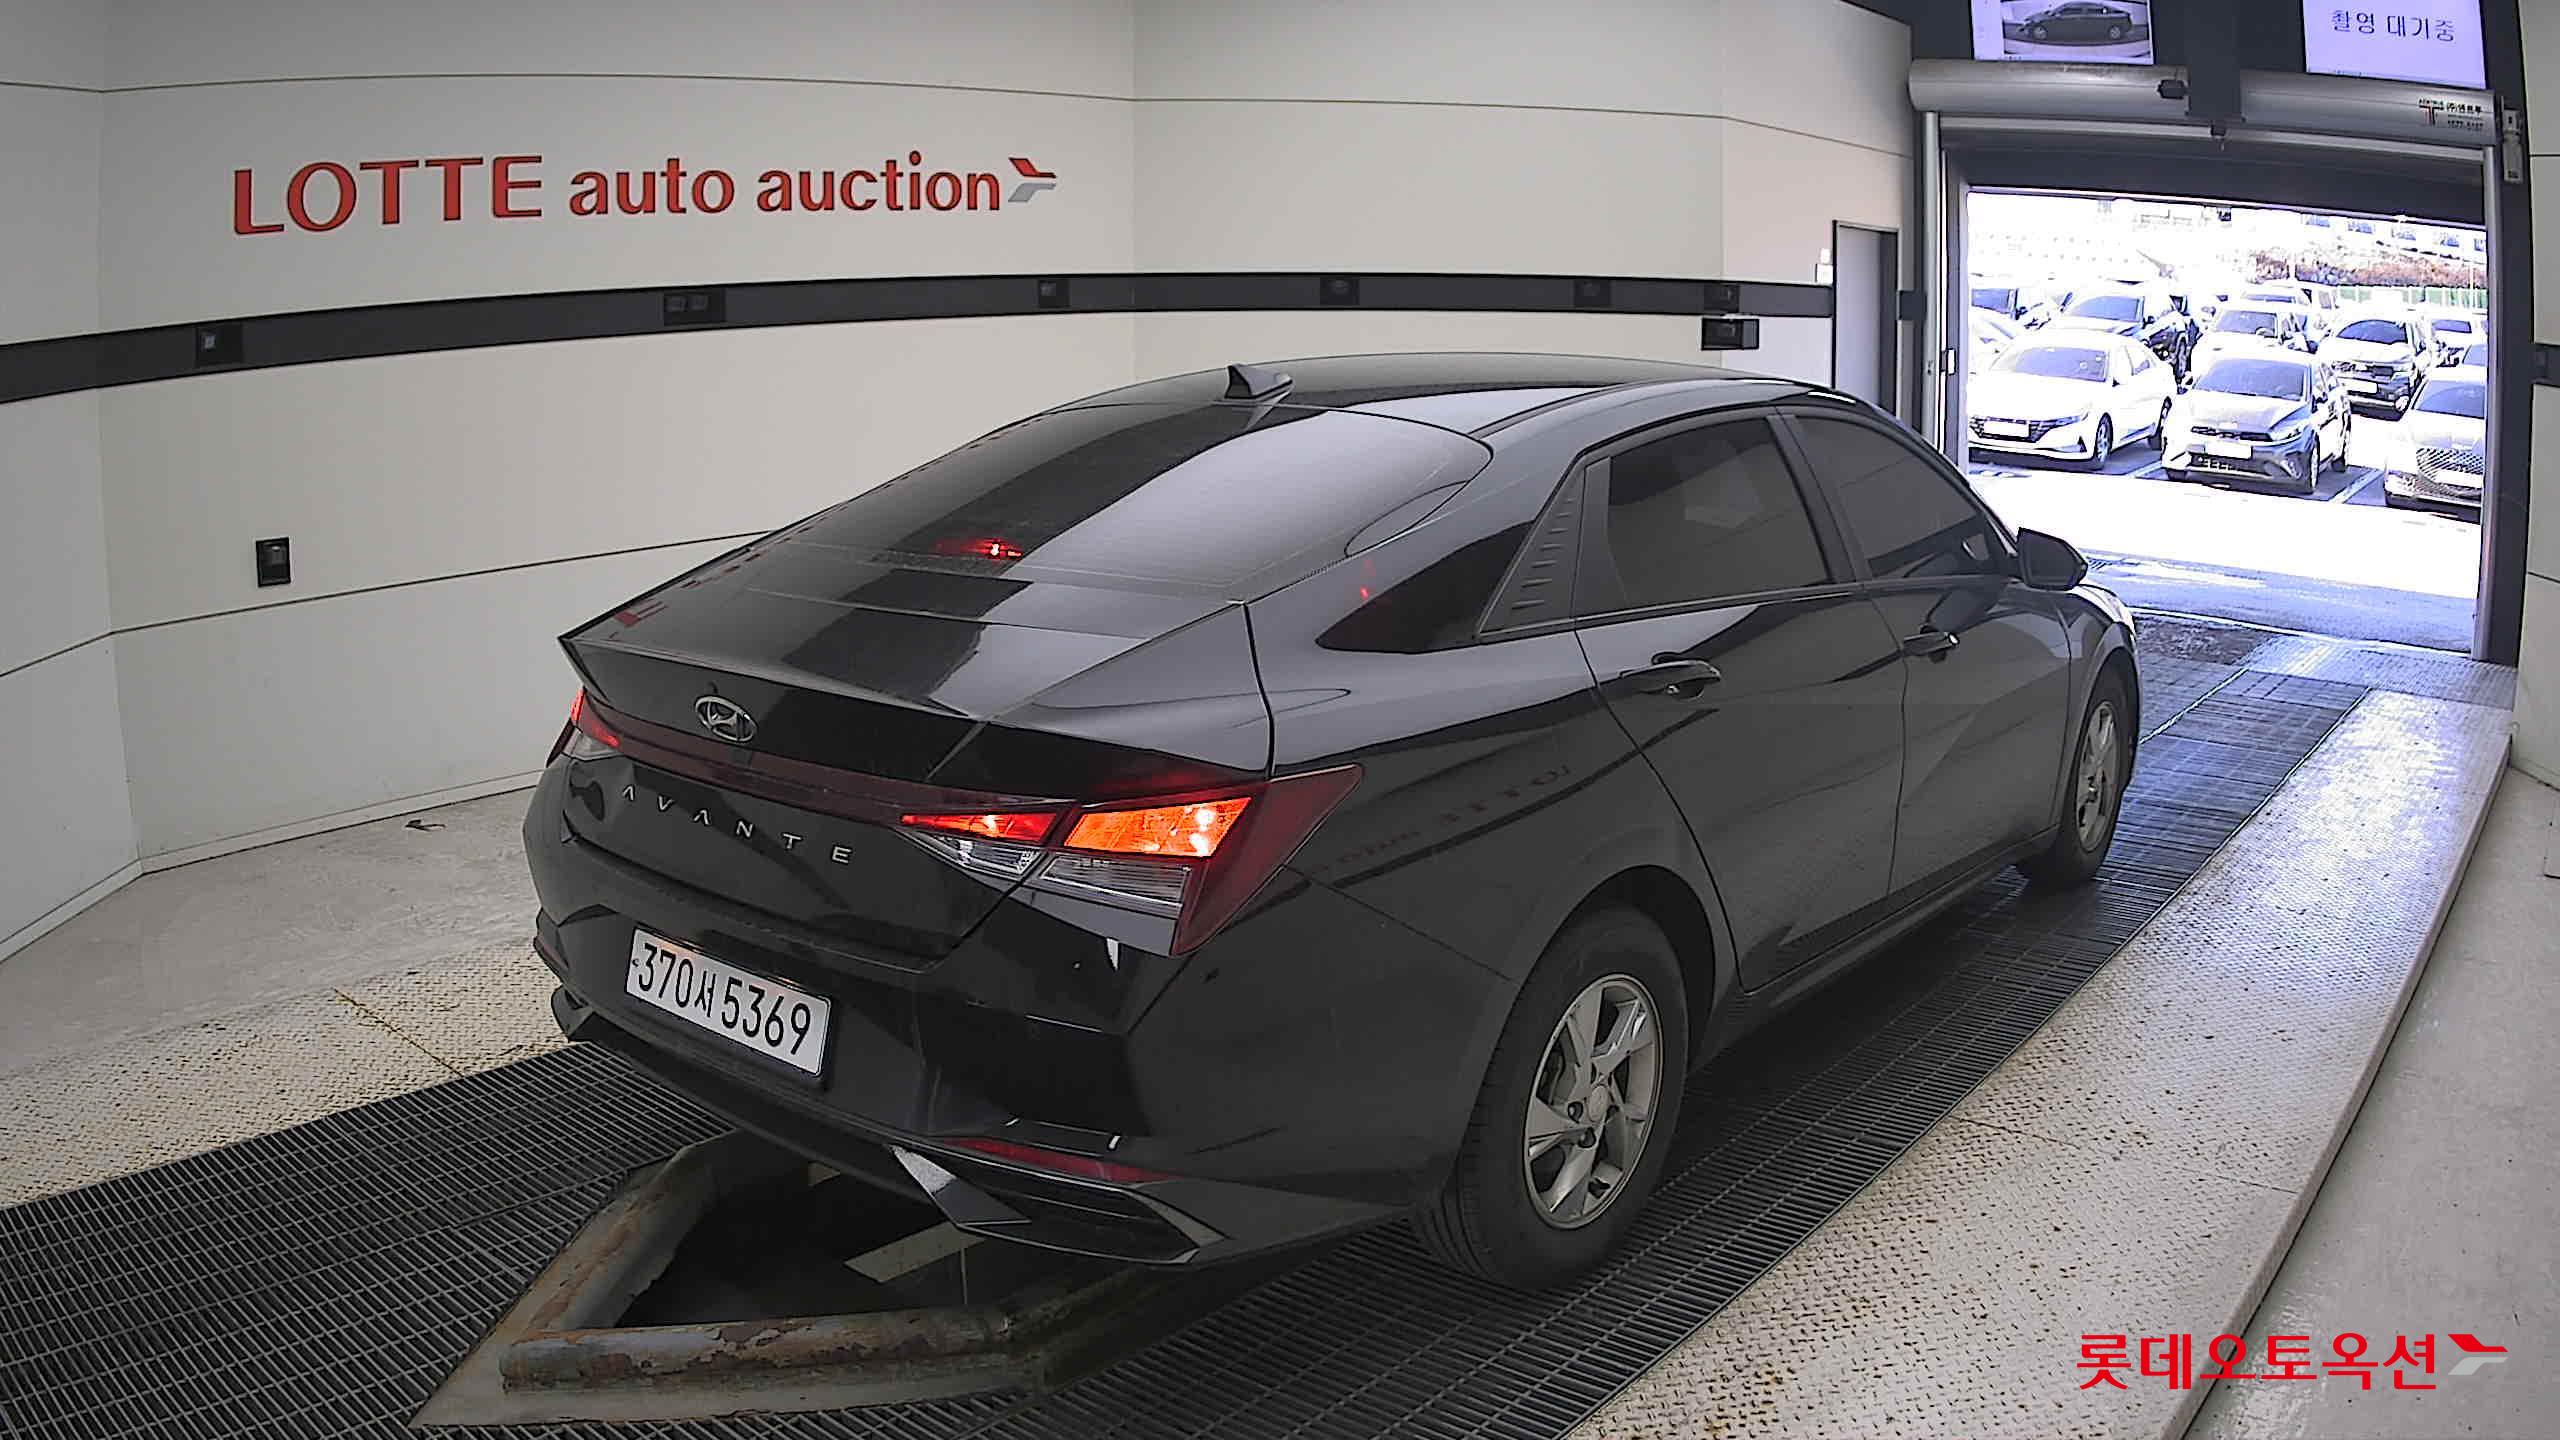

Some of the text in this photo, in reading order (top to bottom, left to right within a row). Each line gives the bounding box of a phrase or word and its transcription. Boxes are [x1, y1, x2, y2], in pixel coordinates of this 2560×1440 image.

[2332, 9, 2456, 42] 촬영 대기중
[233, 150, 1002, 236] LOTTE auto auction
[622, 784, 853, 864] AVANTE
